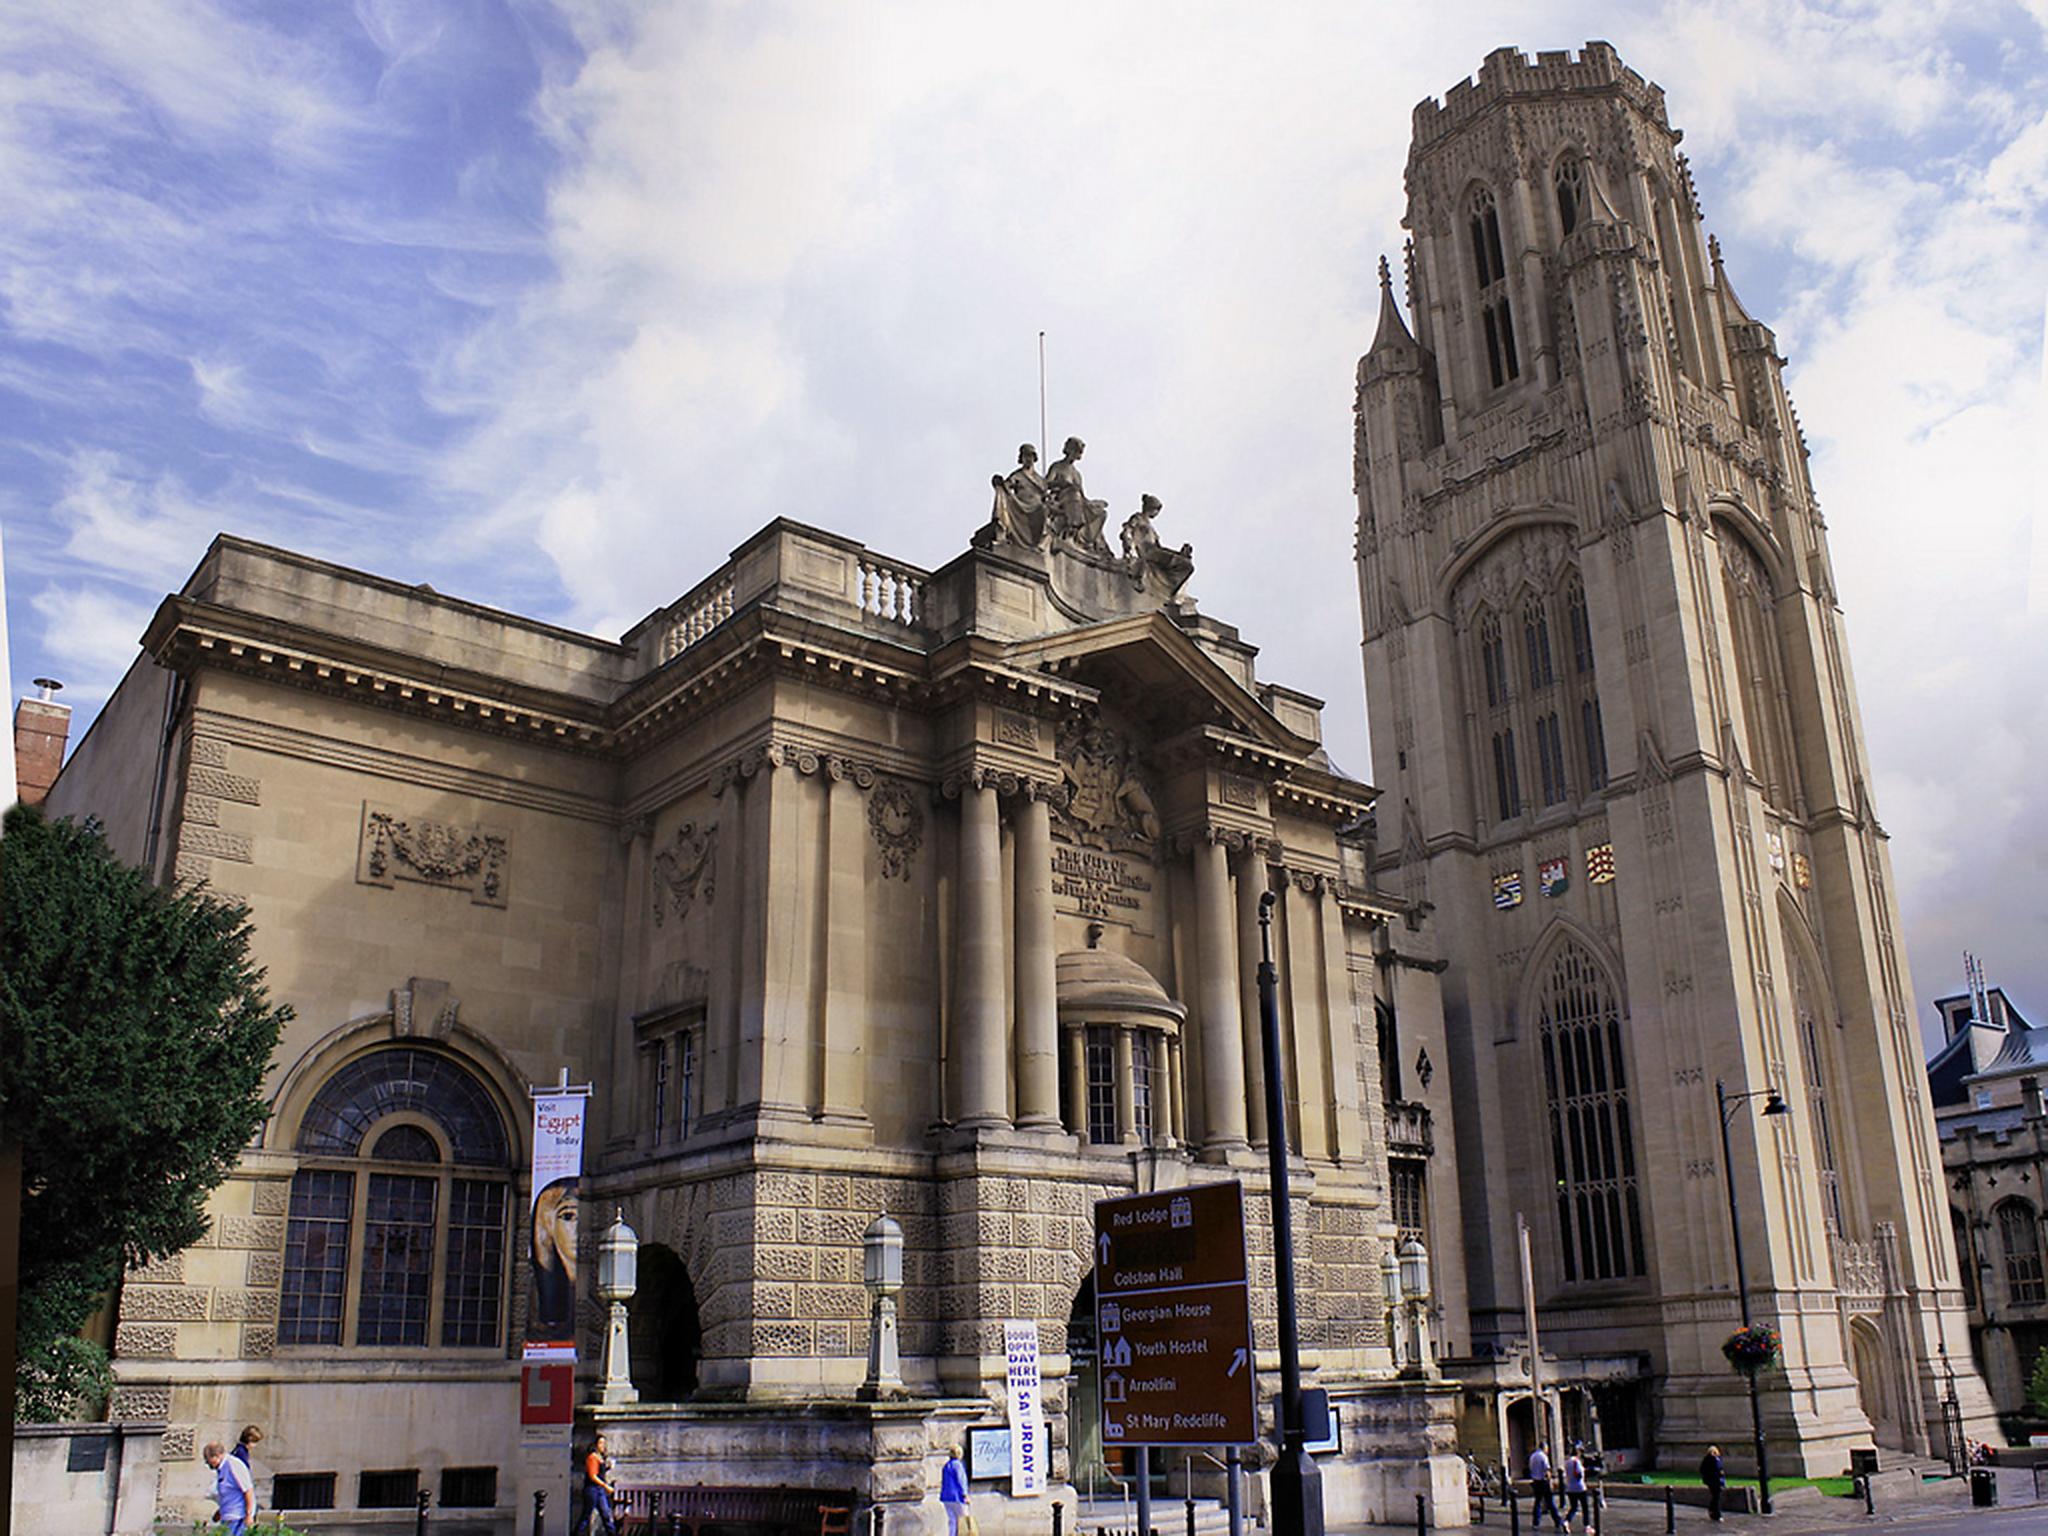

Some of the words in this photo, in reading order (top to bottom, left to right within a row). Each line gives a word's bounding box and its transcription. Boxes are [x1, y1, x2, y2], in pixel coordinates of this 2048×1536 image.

[537, 1104, 556, 1112] Visit
[537, 1113, 581, 1135] Egypt
[555, 1136, 580, 1146] today
[1113, 1211, 1133, 1226] Red
[1136, 1208, 1168, 1224] Lodge
[1113, 1271, 1157, 1287] Colston
[1160, 1266, 1183, 1281] Hall
[1122, 1305, 1173, 1322] Georgian
[1175, 1303, 1212, 1317] House
[1008, 1342, 1036, 1351] OPEN
[1135, 1341, 1167, 1356] Youth
[1169, 1339, 1209, 1354] Hostel
[1009, 1354, 1035, 1363] DAY
[1009, 1366, 1037, 1376] HERE
[1011, 1379, 1037, 1387] THIS
[1129, 1377, 1177, 1392] Arnolfini
[1126, 1413, 1139, 1429] St
[1142, 1414, 1169, 1430] Mary
[1173, 1412, 1227, 1429] Redcliffe
